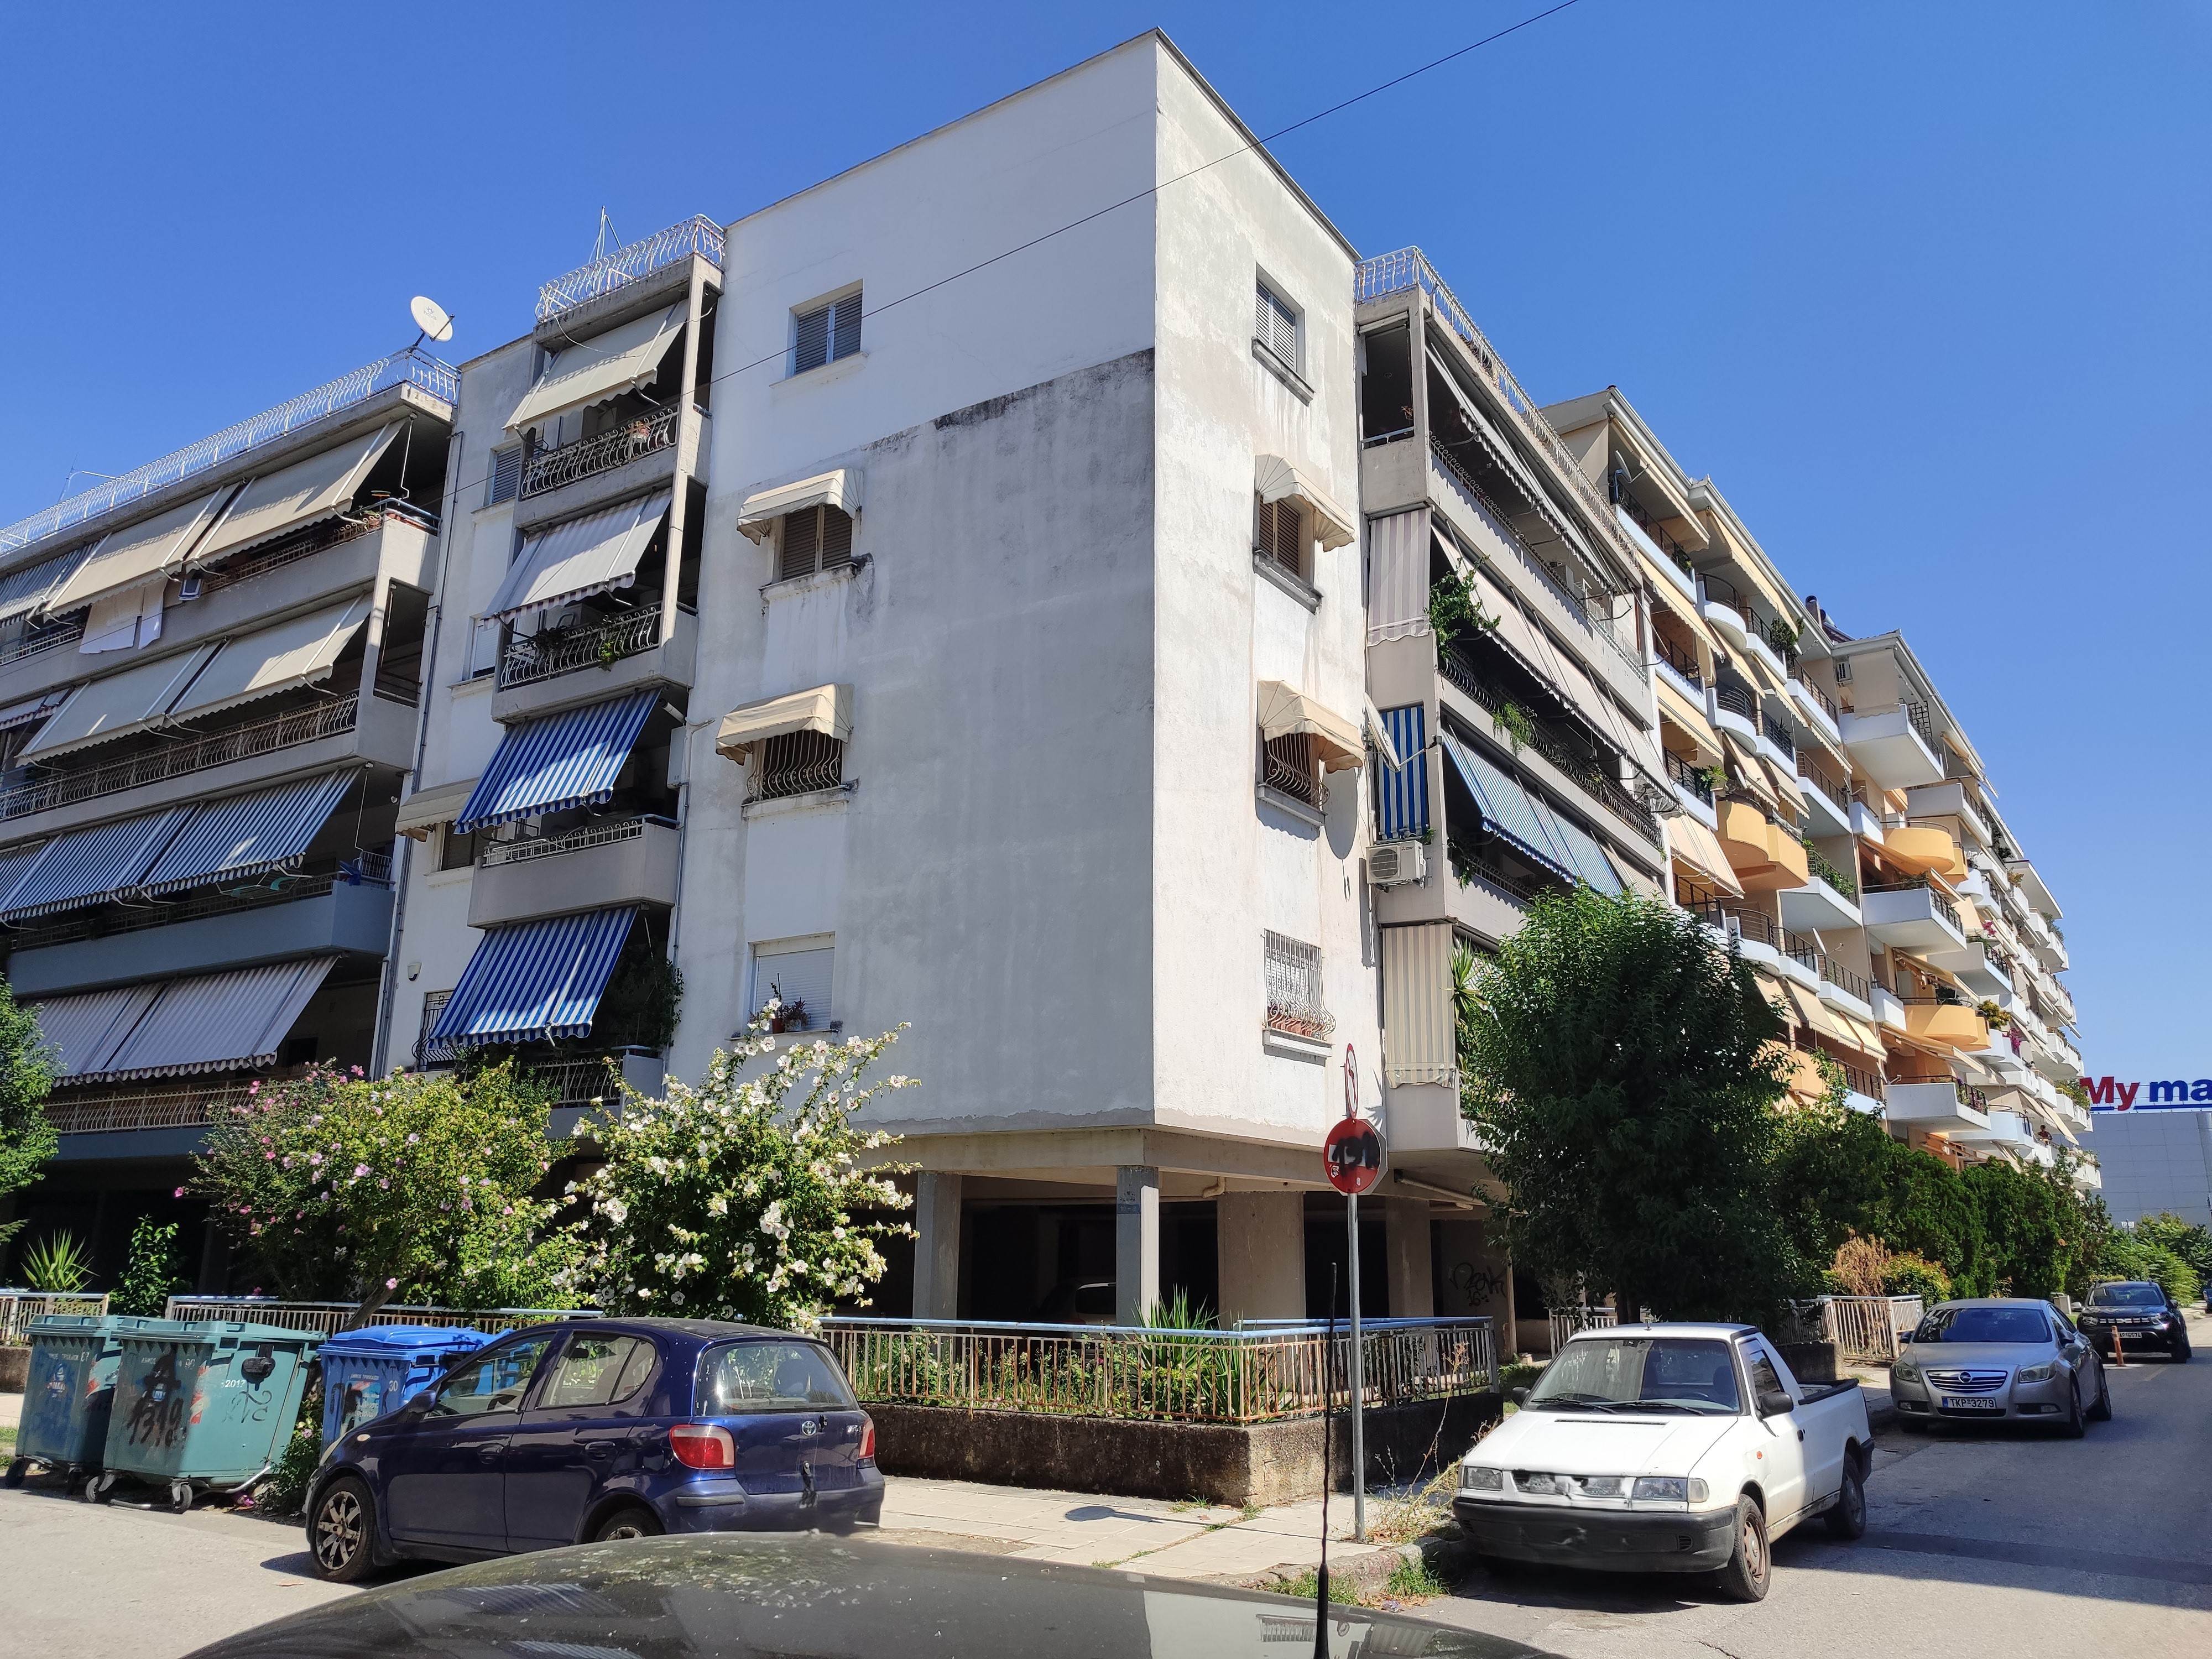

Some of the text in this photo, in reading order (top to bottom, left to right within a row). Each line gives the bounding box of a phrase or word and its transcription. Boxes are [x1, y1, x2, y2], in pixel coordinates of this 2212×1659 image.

[2079, 1076, 2212, 1111] My ma
[389, 1380, 398, 1392] 30
[1950, 1398, 1994, 1408] TKP-3279
